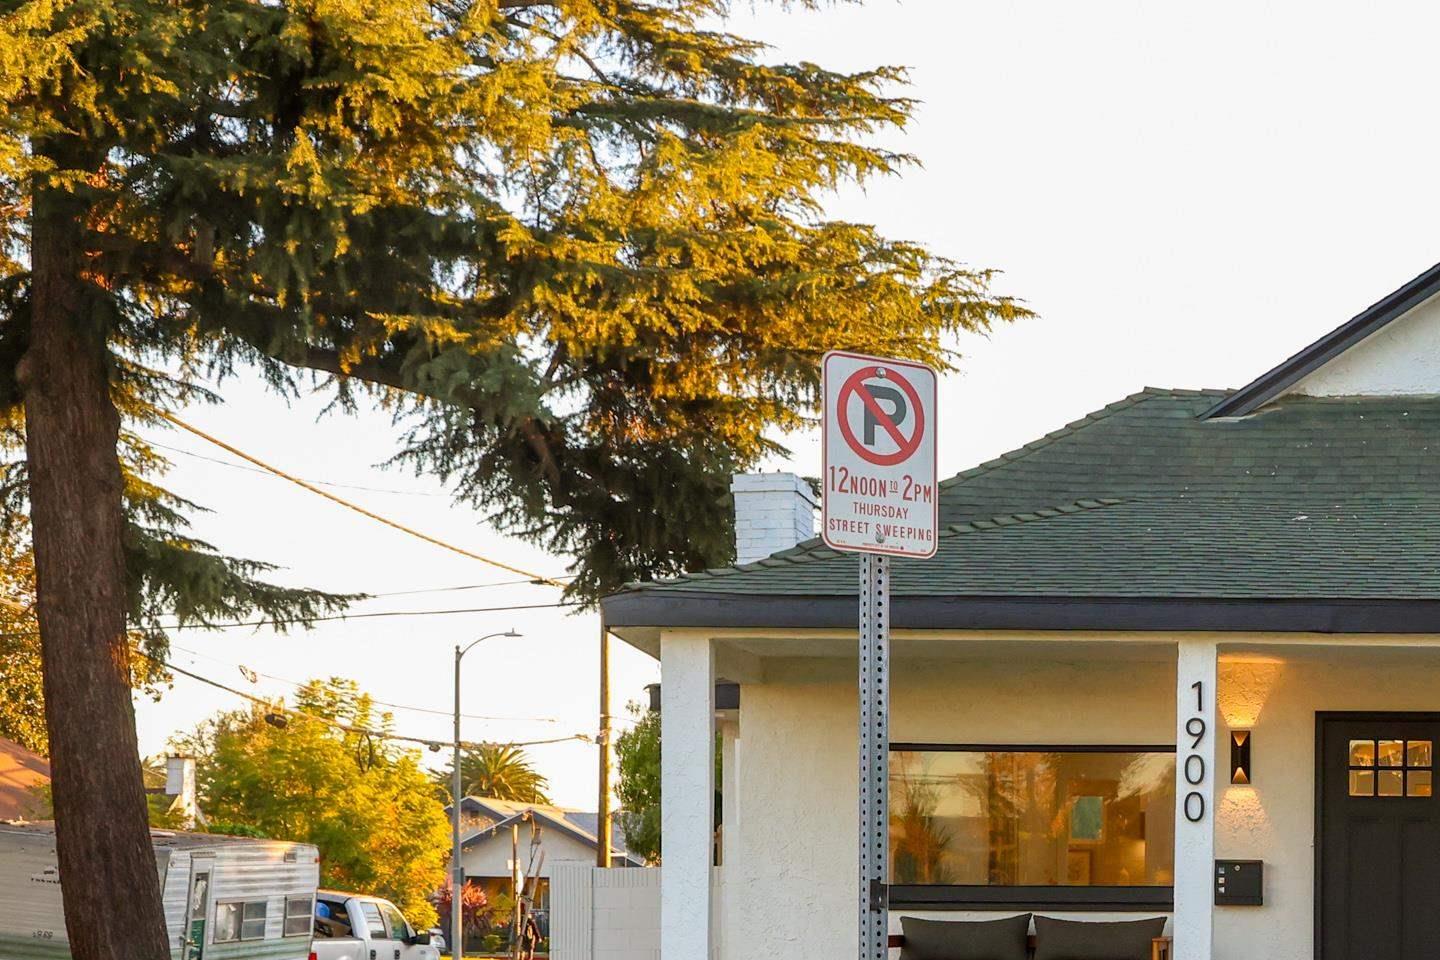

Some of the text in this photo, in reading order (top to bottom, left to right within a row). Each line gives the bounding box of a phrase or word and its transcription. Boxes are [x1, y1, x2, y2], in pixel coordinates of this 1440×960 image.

[902, 474, 932, 504] 2PM
[853, 501, 909, 520] THURSDAY
[829, 518, 932, 541] STREET SWEEPING
[1183, 680, 1206, 823] 1900
